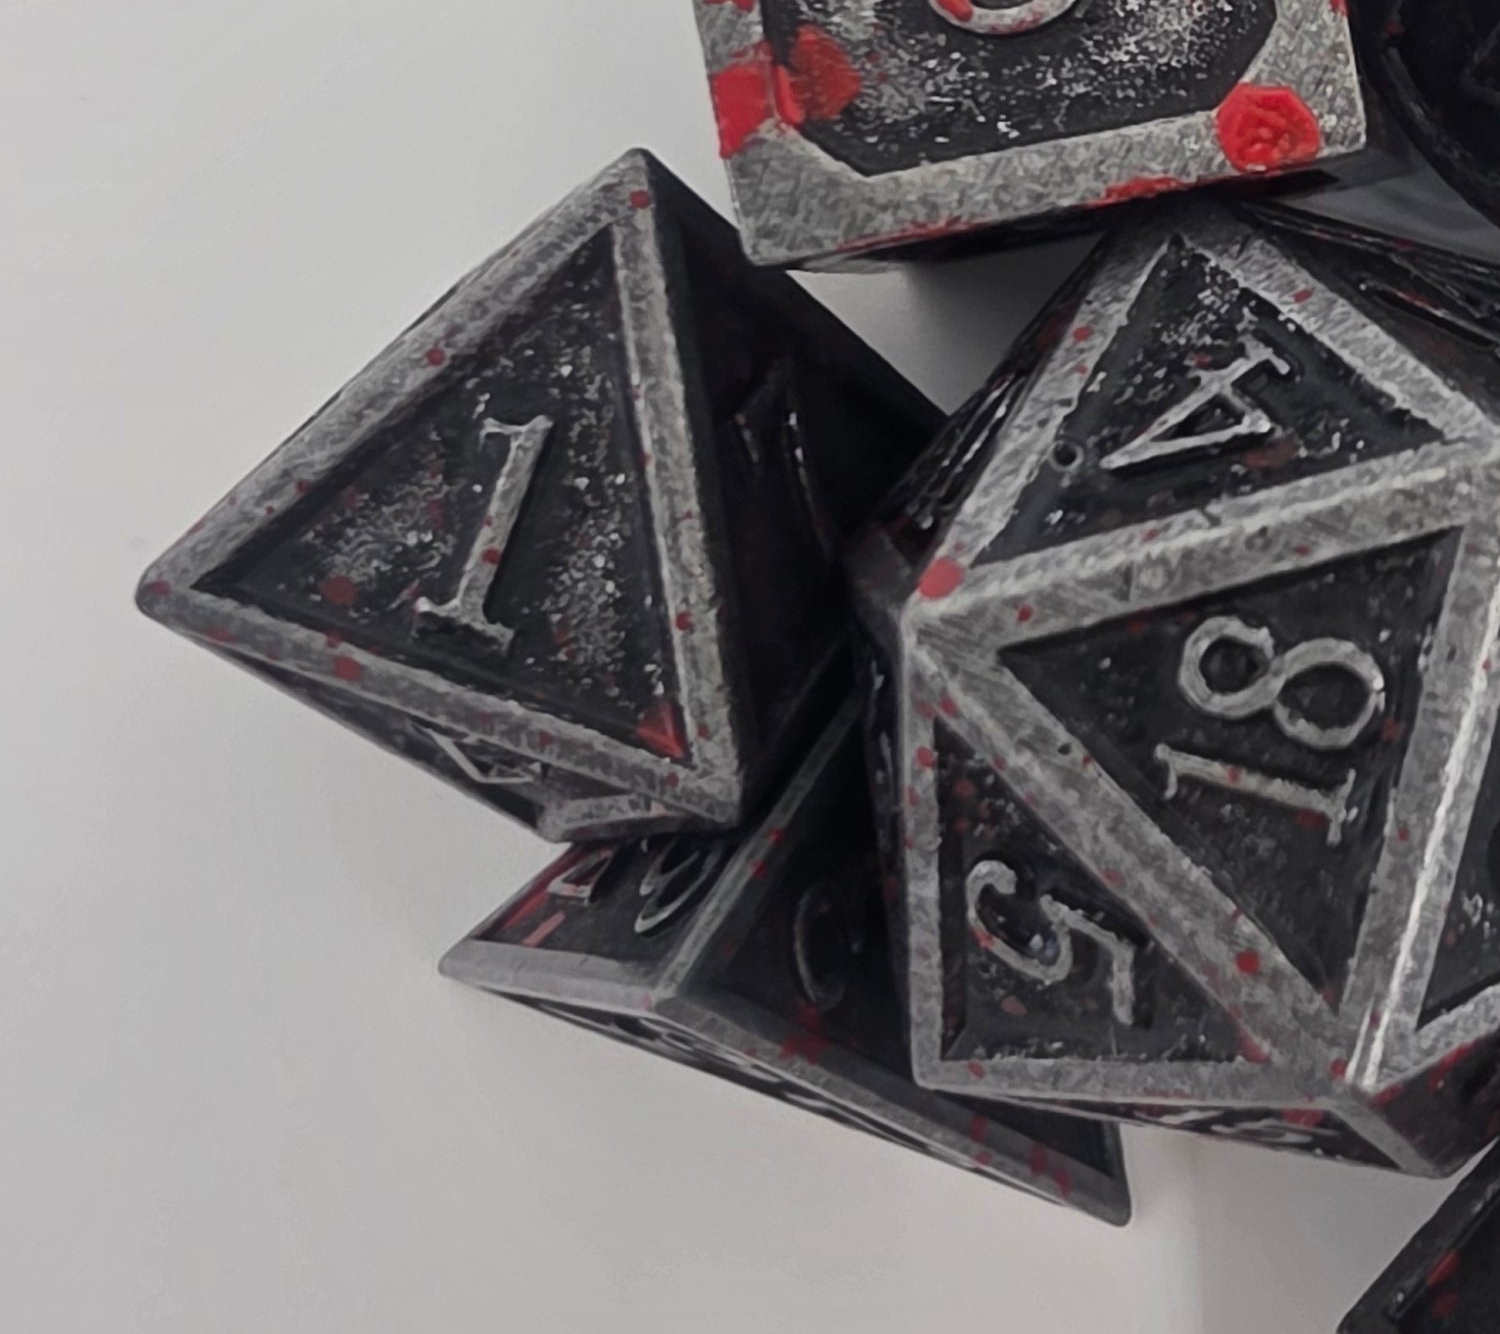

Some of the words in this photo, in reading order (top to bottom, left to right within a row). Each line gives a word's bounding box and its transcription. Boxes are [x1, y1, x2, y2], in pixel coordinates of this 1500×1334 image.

[1098, 333, 1291, 469] 4
[409, 414, 553, 655] 1
[1154, 615, 1387, 845] 18
[965, 858, 1134, 1025] 5
